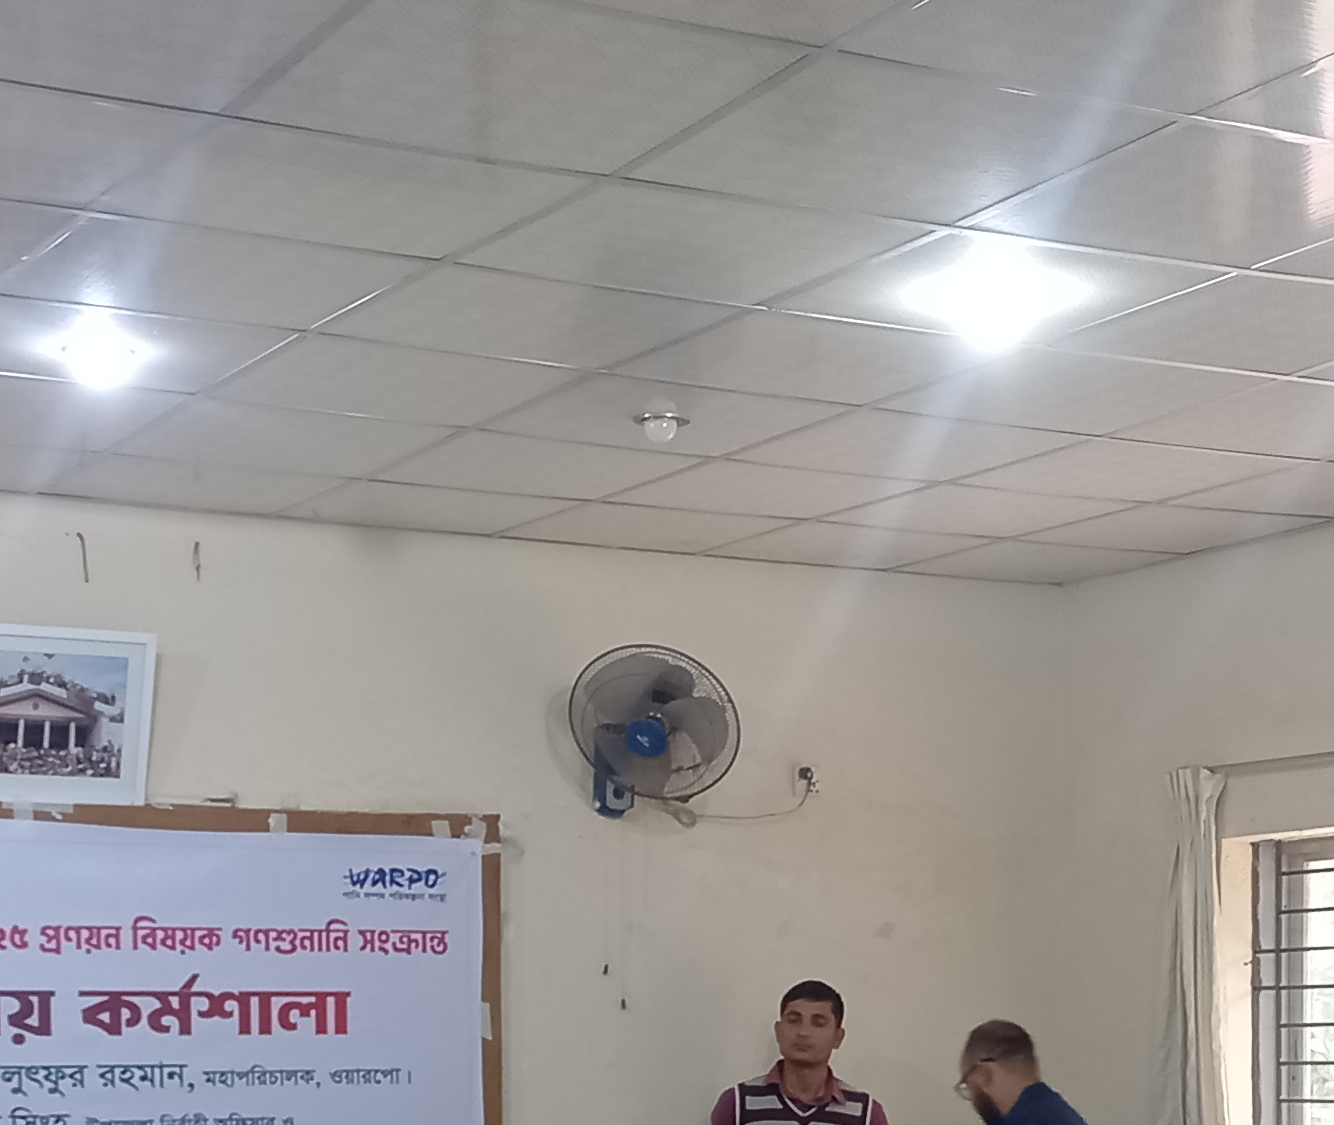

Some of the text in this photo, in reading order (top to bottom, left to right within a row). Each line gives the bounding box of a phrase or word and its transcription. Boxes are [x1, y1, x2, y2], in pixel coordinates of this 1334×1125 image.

[347, 867, 440, 890] WARPO
[39, 924, 123, 956] প্রণয়ন
[130, 915, 223, 956] বিষয়ক
[231, 918, 350, 955] গণশুনানি
[356, 928, 450, 956] সংক্রান্ত
[77, 972, 352, 1037] কর্মশালা
